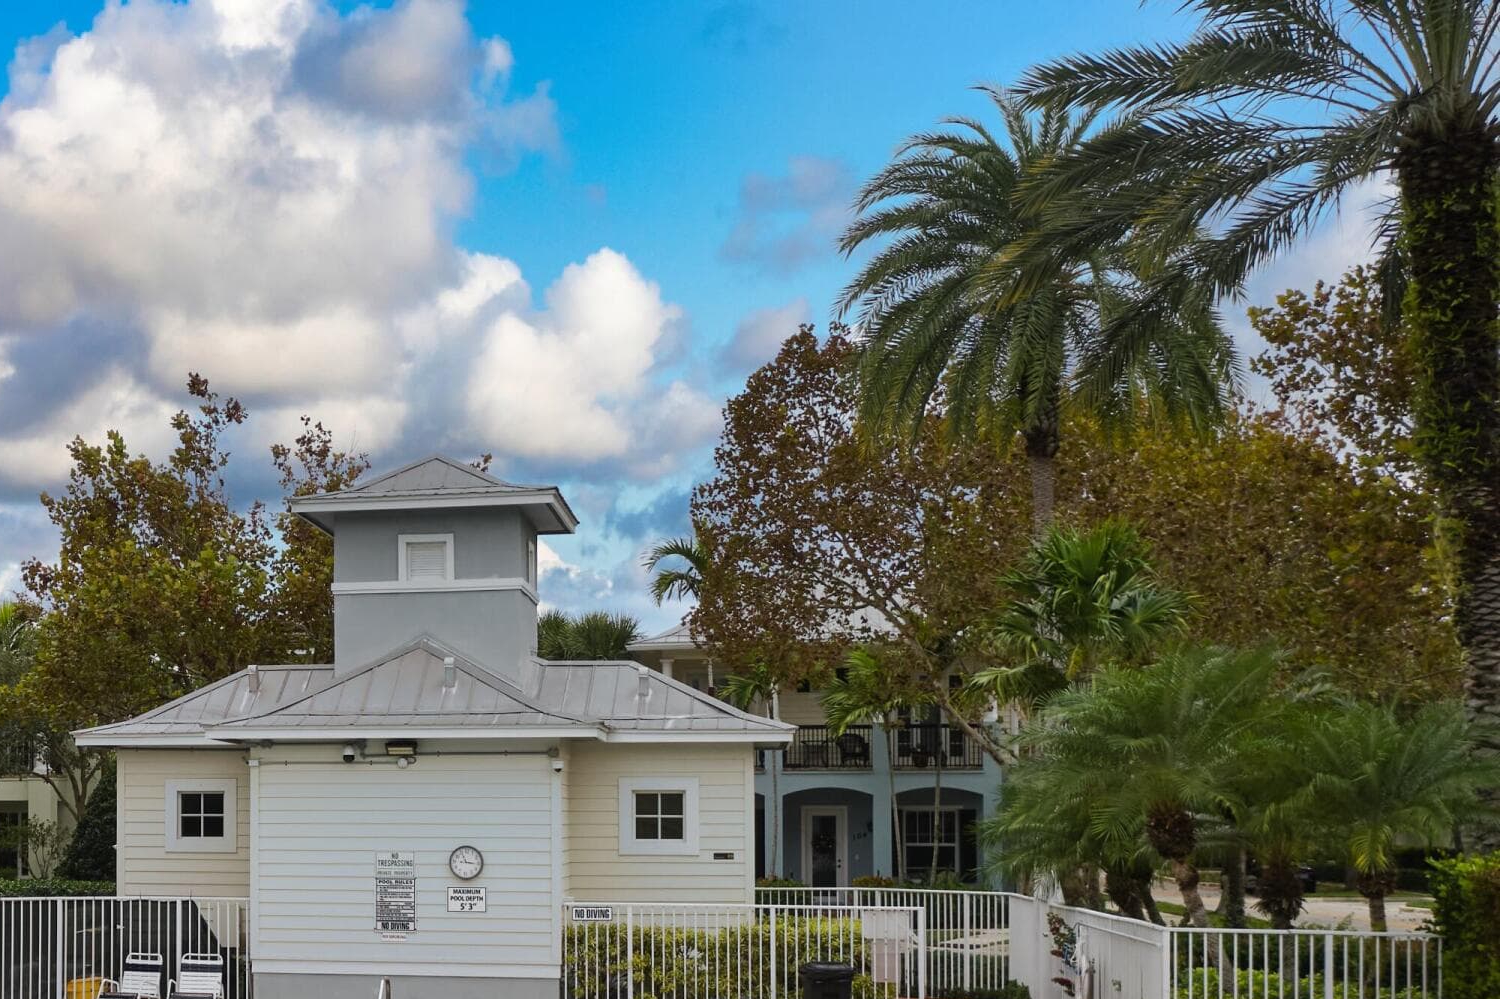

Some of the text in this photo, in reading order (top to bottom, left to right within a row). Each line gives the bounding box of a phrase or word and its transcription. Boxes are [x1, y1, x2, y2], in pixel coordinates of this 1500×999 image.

[377, 859, 413, 867] TRESPASSING
[574, 909, 610, 919] NO DIVING
[381, 921, 410, 930] NO DIVING
